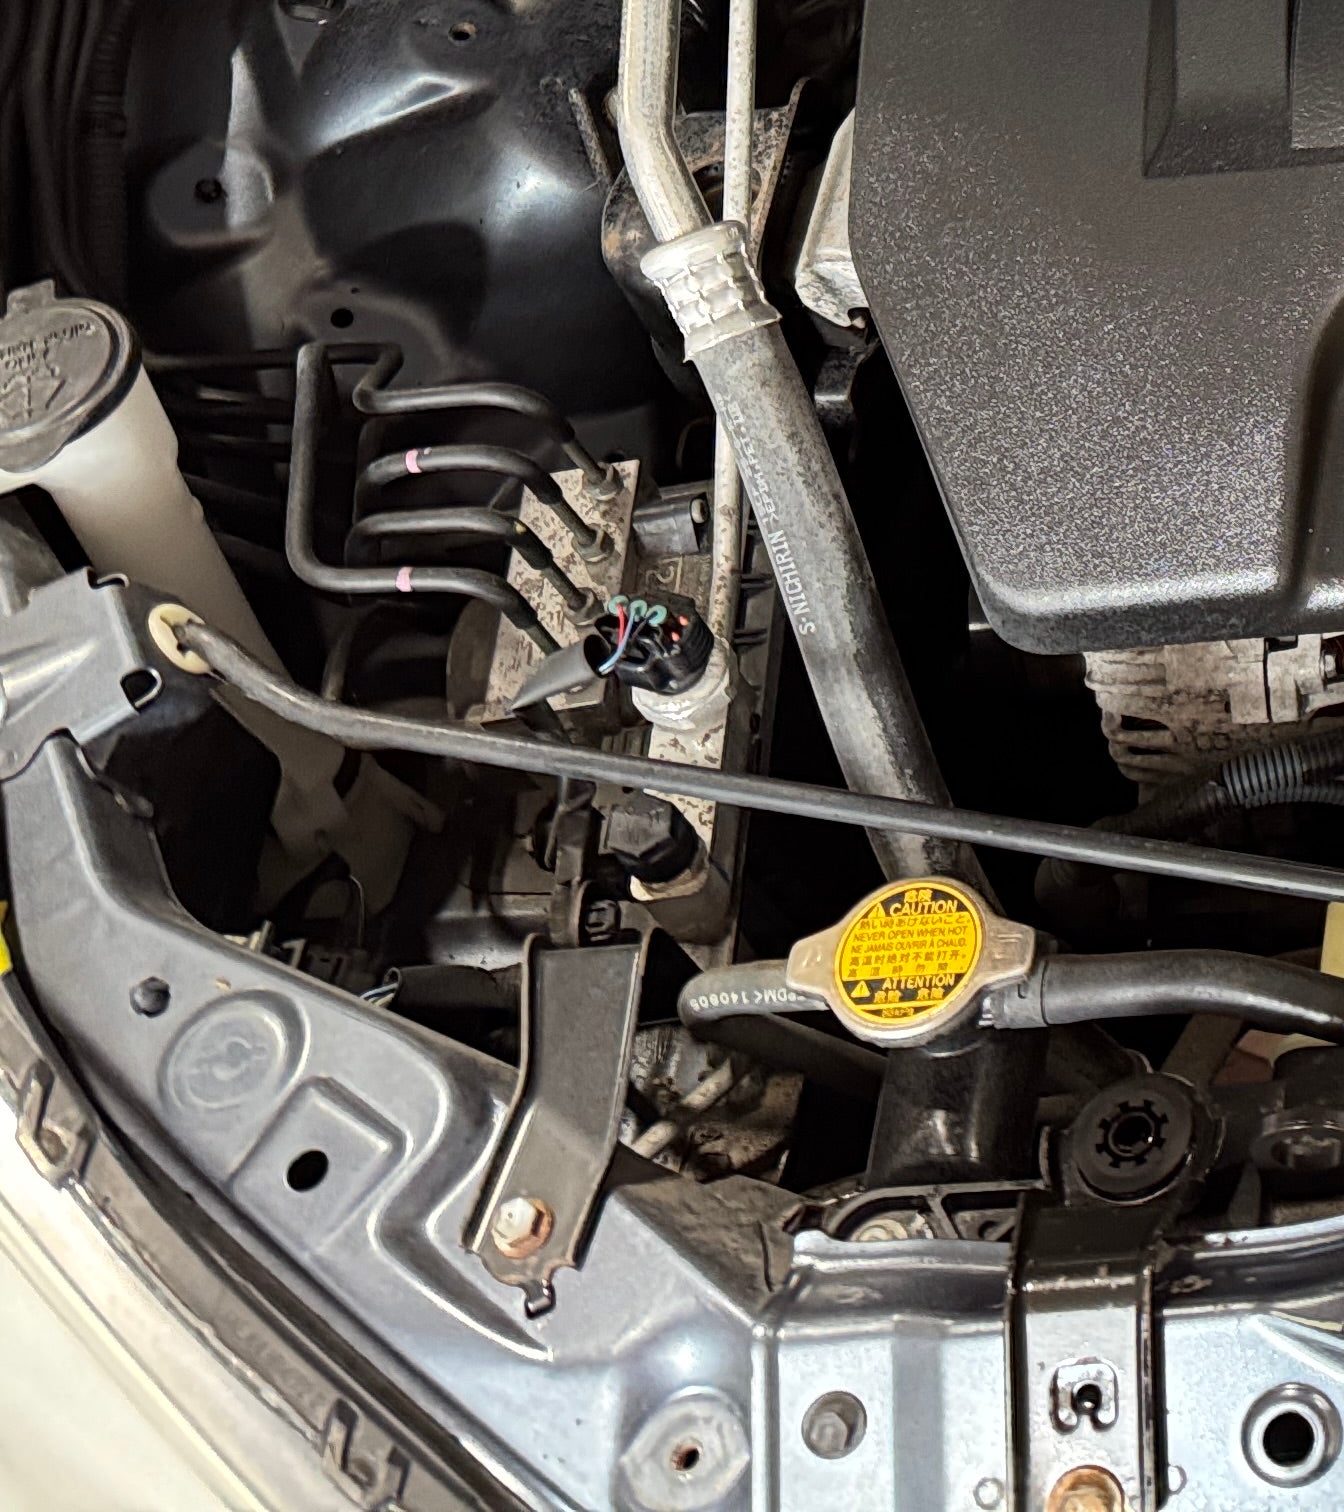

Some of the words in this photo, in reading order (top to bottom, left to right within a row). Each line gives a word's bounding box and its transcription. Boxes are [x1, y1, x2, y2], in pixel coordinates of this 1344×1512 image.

[889, 899, 958, 917] CAUTION
[853, 930, 886, 943] NEVER
[887, 928, 915, 941] OPEN
[916, 926, 946, 938] WHEN
[947, 925, 968, 936] HOT
[881, 973, 956, 991] ATTENTION
